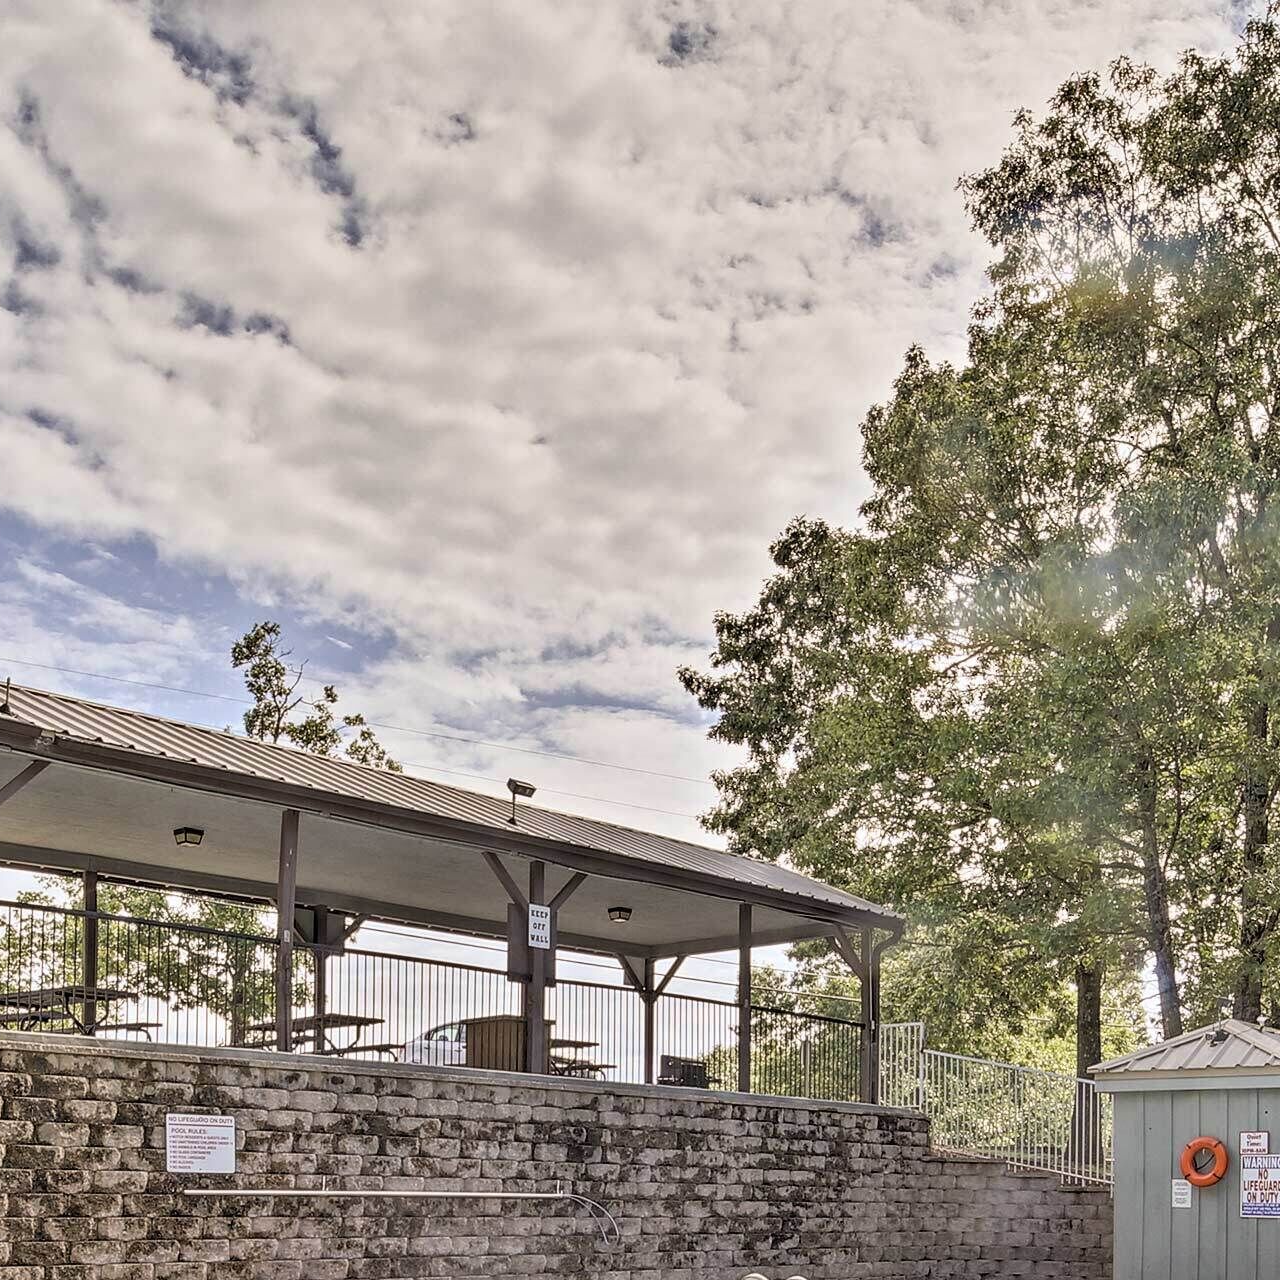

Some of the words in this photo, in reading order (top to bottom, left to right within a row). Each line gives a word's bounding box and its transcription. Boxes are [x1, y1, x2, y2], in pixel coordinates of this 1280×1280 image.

[531, 909, 549, 919] KEEP
[533, 922, 546, 931] OFF
[531, 934, 549, 944] WALL
[1258, 1169, 1269, 1180] NO
[1247, 1192, 1257, 1203] ON
[1260, 1192, 1279, 1203] DUTY
